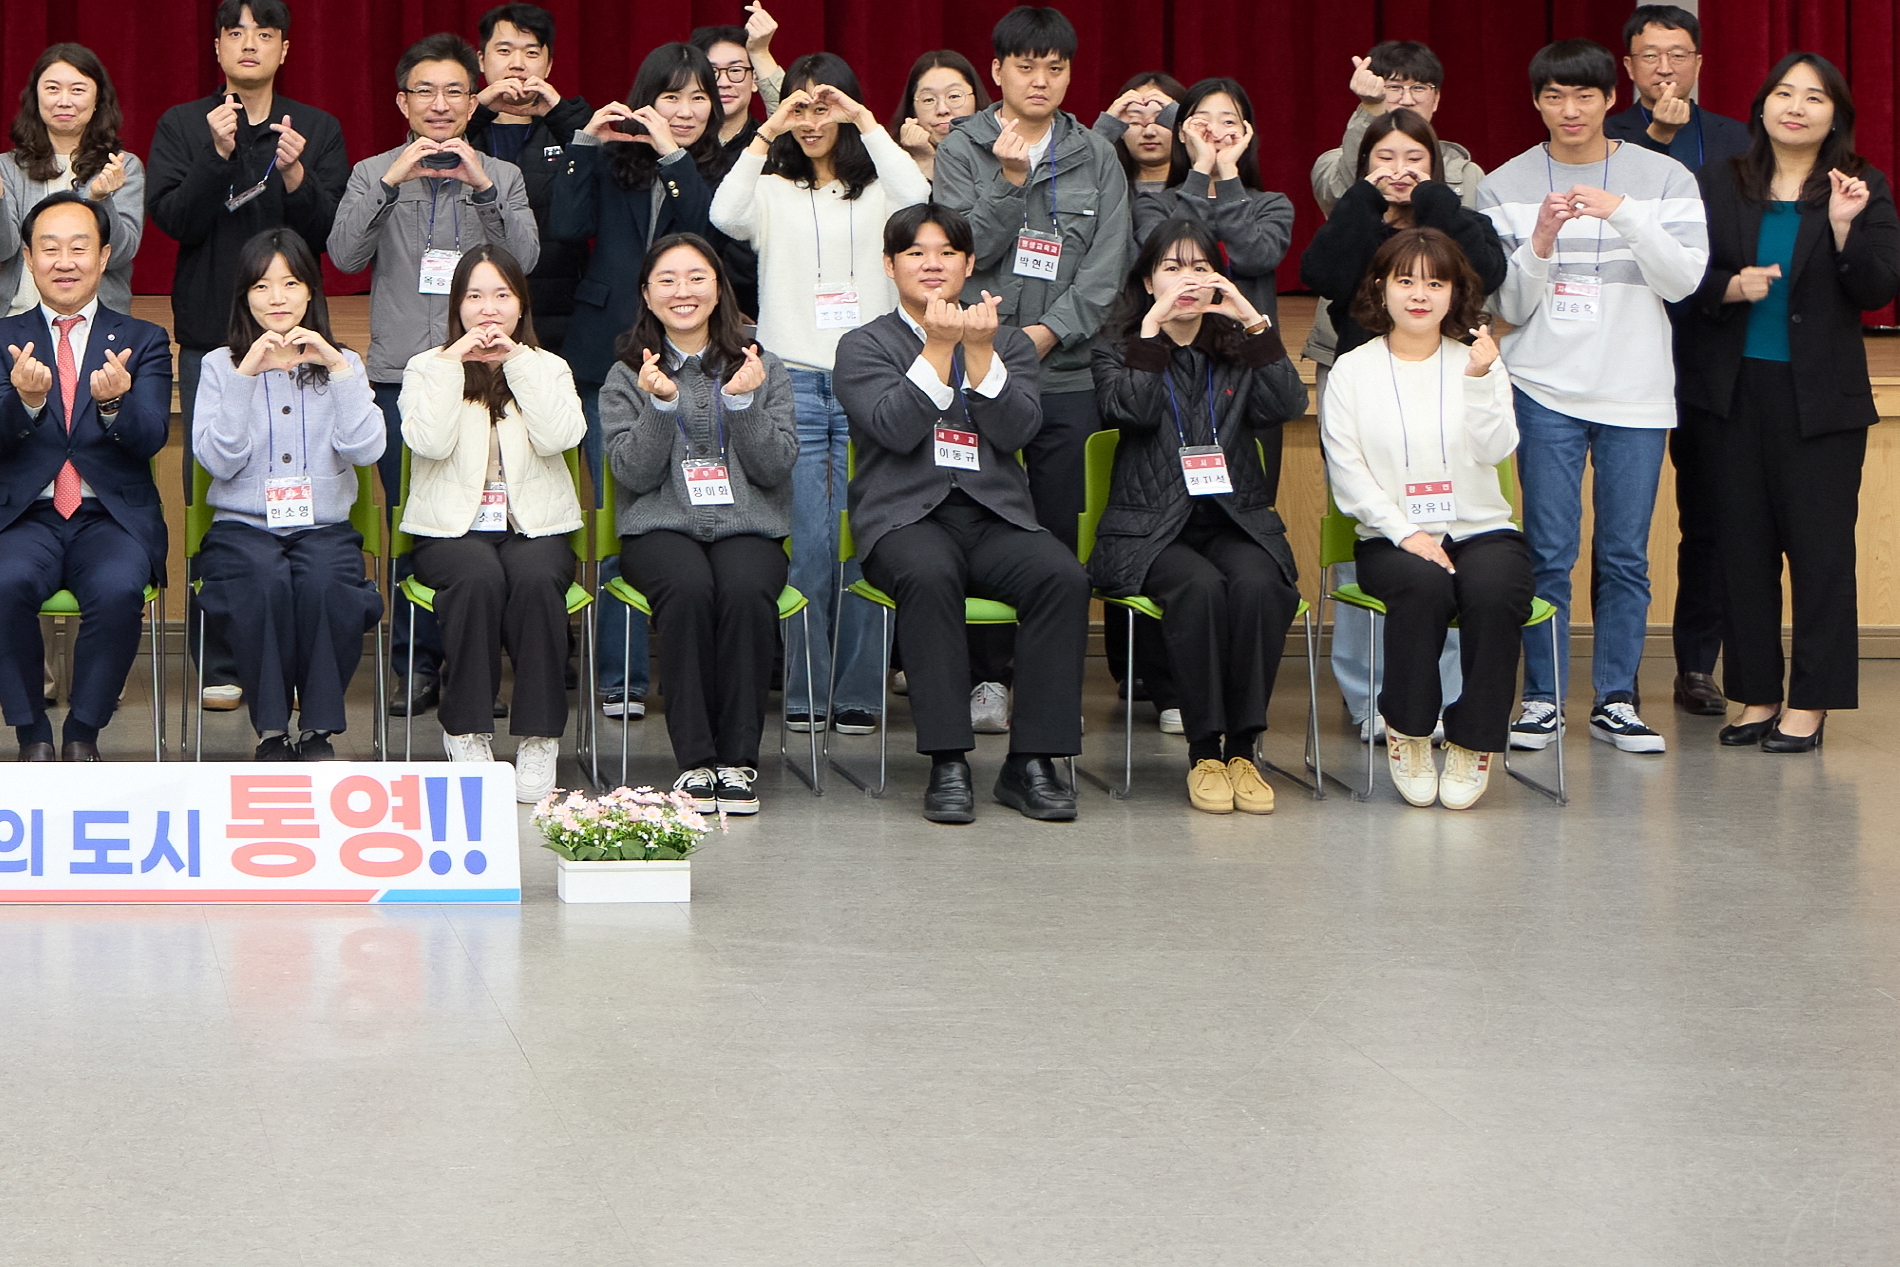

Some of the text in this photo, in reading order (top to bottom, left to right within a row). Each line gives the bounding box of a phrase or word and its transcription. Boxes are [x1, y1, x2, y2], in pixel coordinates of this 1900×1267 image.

[1410, 501, 1452, 515] 장유나
[69, 810, 201, 879] 도시
[226, 772, 488, 878] 통영!!
